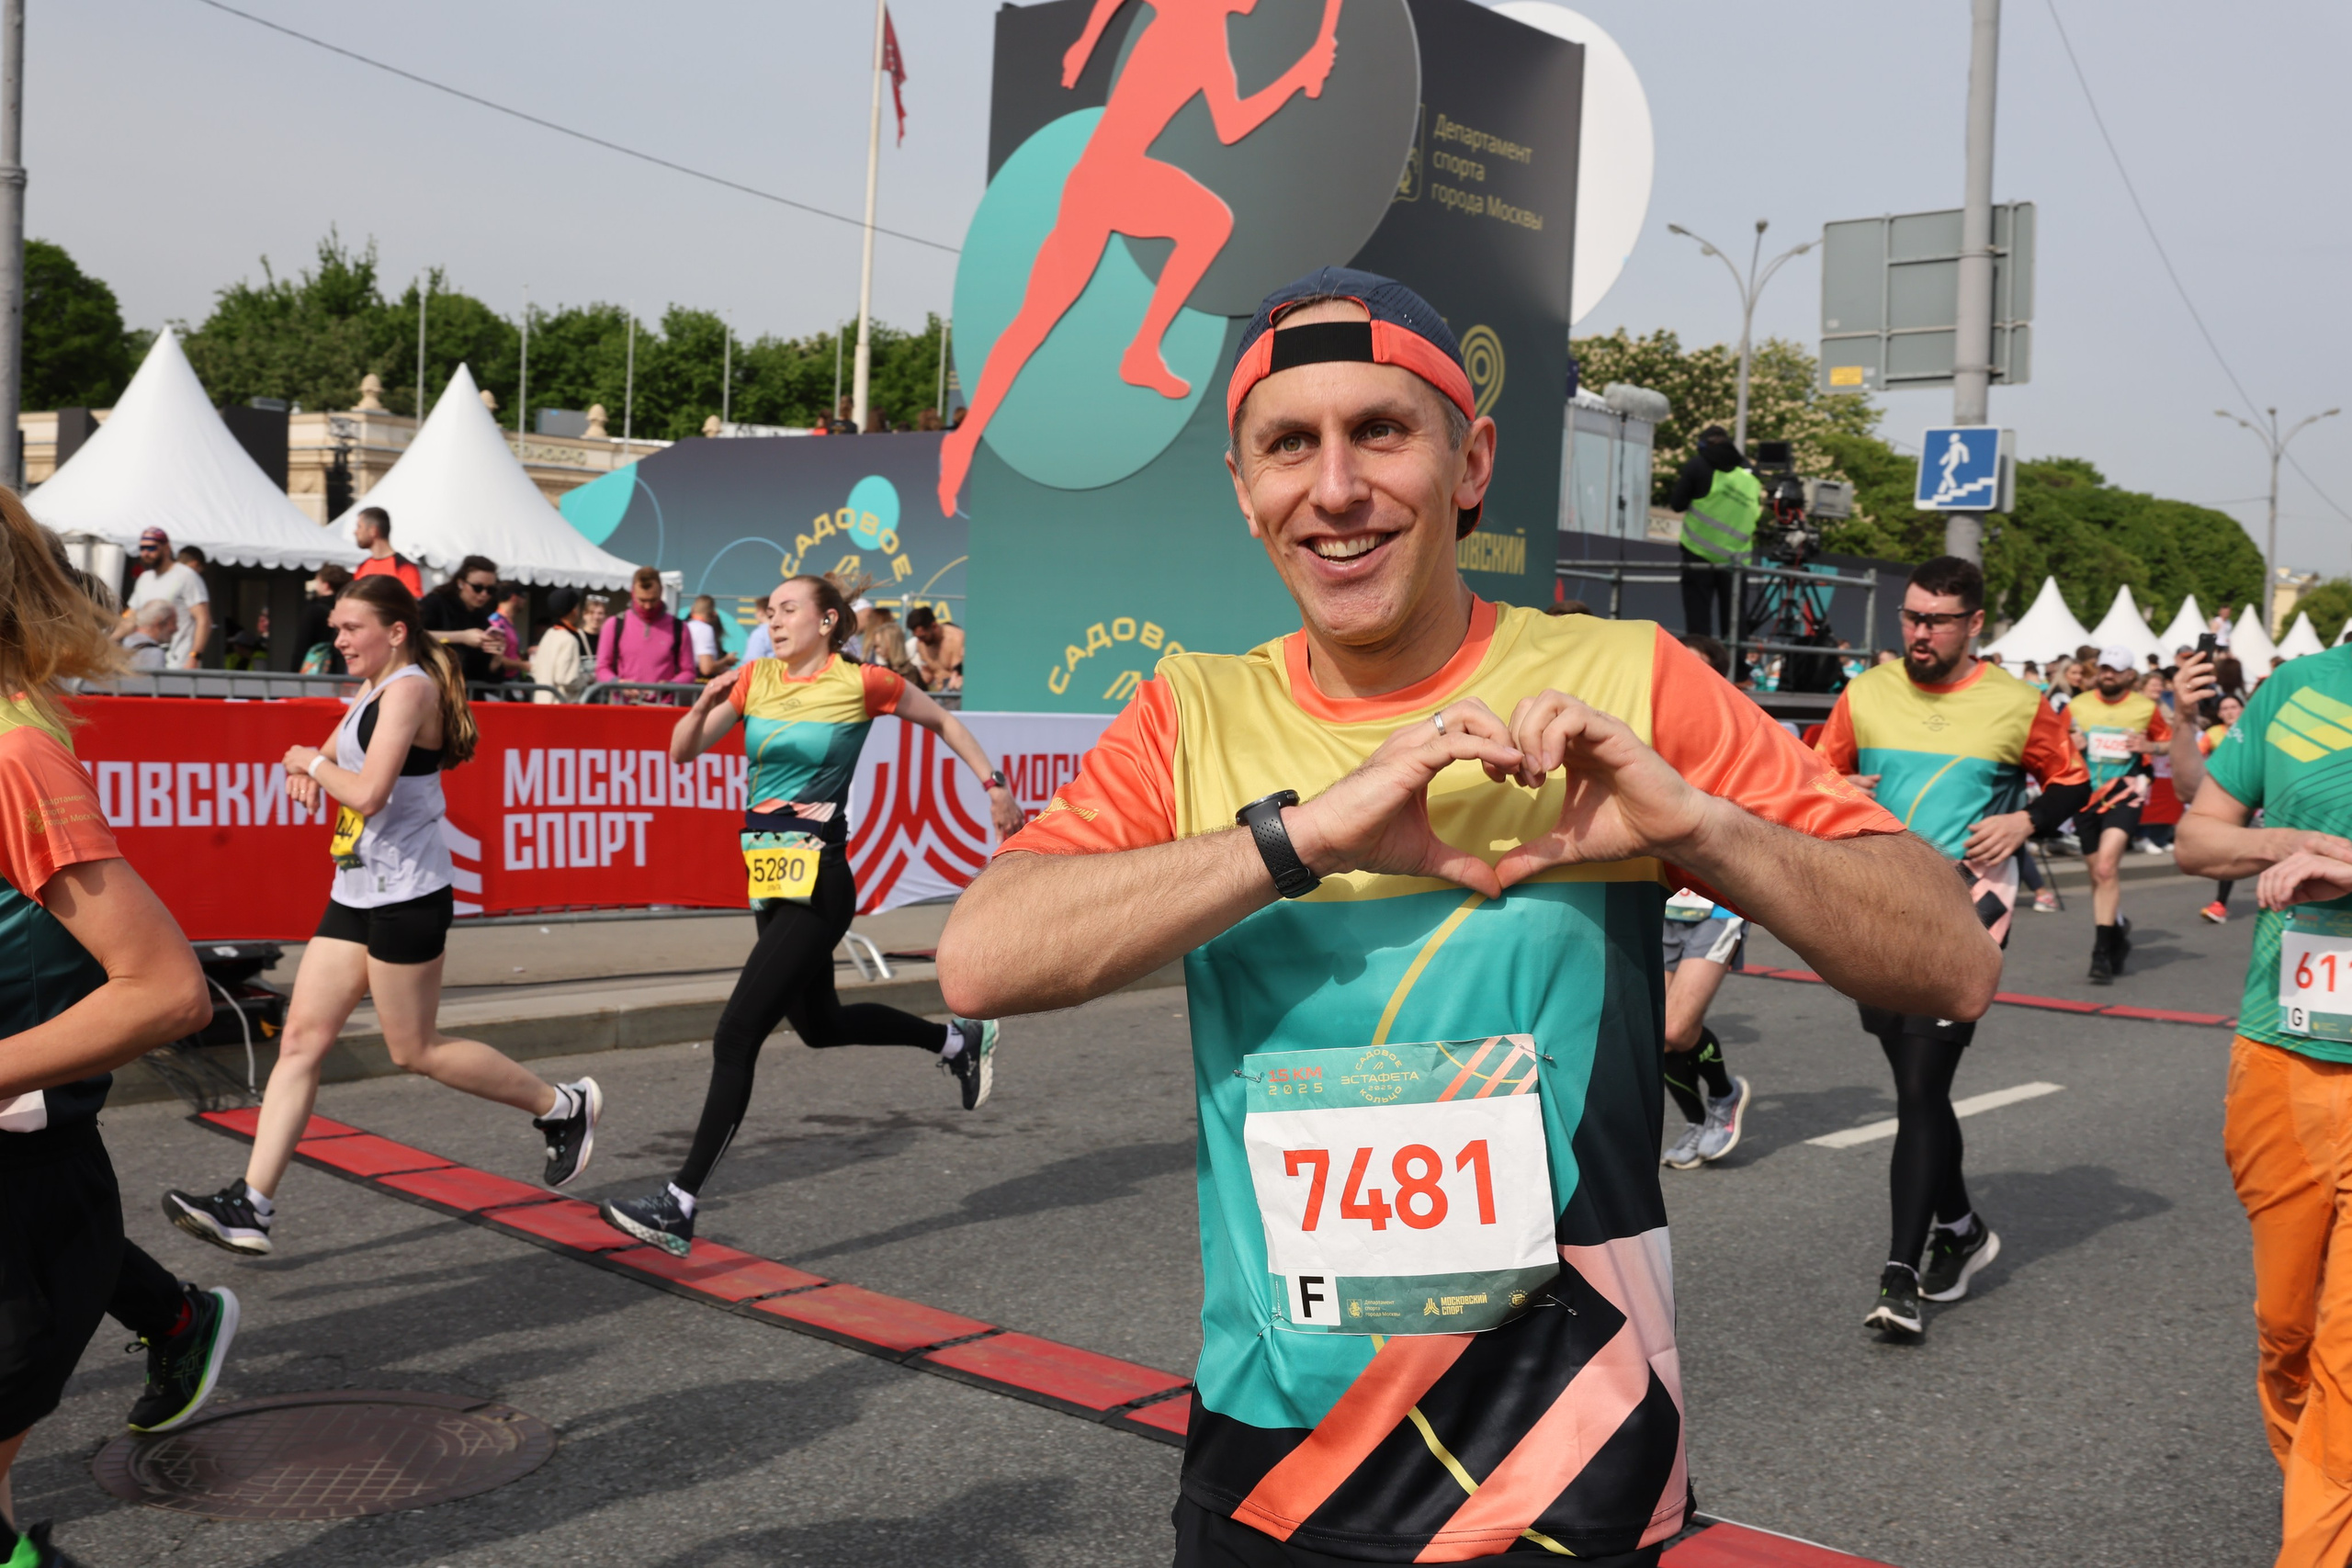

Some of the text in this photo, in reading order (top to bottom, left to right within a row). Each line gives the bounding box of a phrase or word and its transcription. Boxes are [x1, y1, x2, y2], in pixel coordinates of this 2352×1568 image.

[1432, 113, 1533, 164] Департамент
[1432, 150, 1486, 182] спорта
[1430, 183, 1544, 231] города Москвы
[780, 507, 912, 582] САДОВОЕ
[503, 812, 654, 871] СПОРТ
[753, 856, 805, 883] 5280
[2294, 951, 2352, 993] 61
[2290, 1007, 2304, 1027] G
[1354, 1048, 1403, 1071] САДОВОЕ
[1268, 1068, 1290, 1082] 15
[1340, 1071, 1419, 1085] ЭСТАФЕТА
[1268, 1082, 1324, 1096] 2025
[1359, 1085, 1403, 1104] КОЛЬЦО
[1283, 1139, 1497, 1231] 7481
[1298, 1275, 1325, 1318] F
[1440, 1292, 1488, 1306] МОСКОВСКИЙ
[1441, 1305, 1464, 1315] СПОРТ
